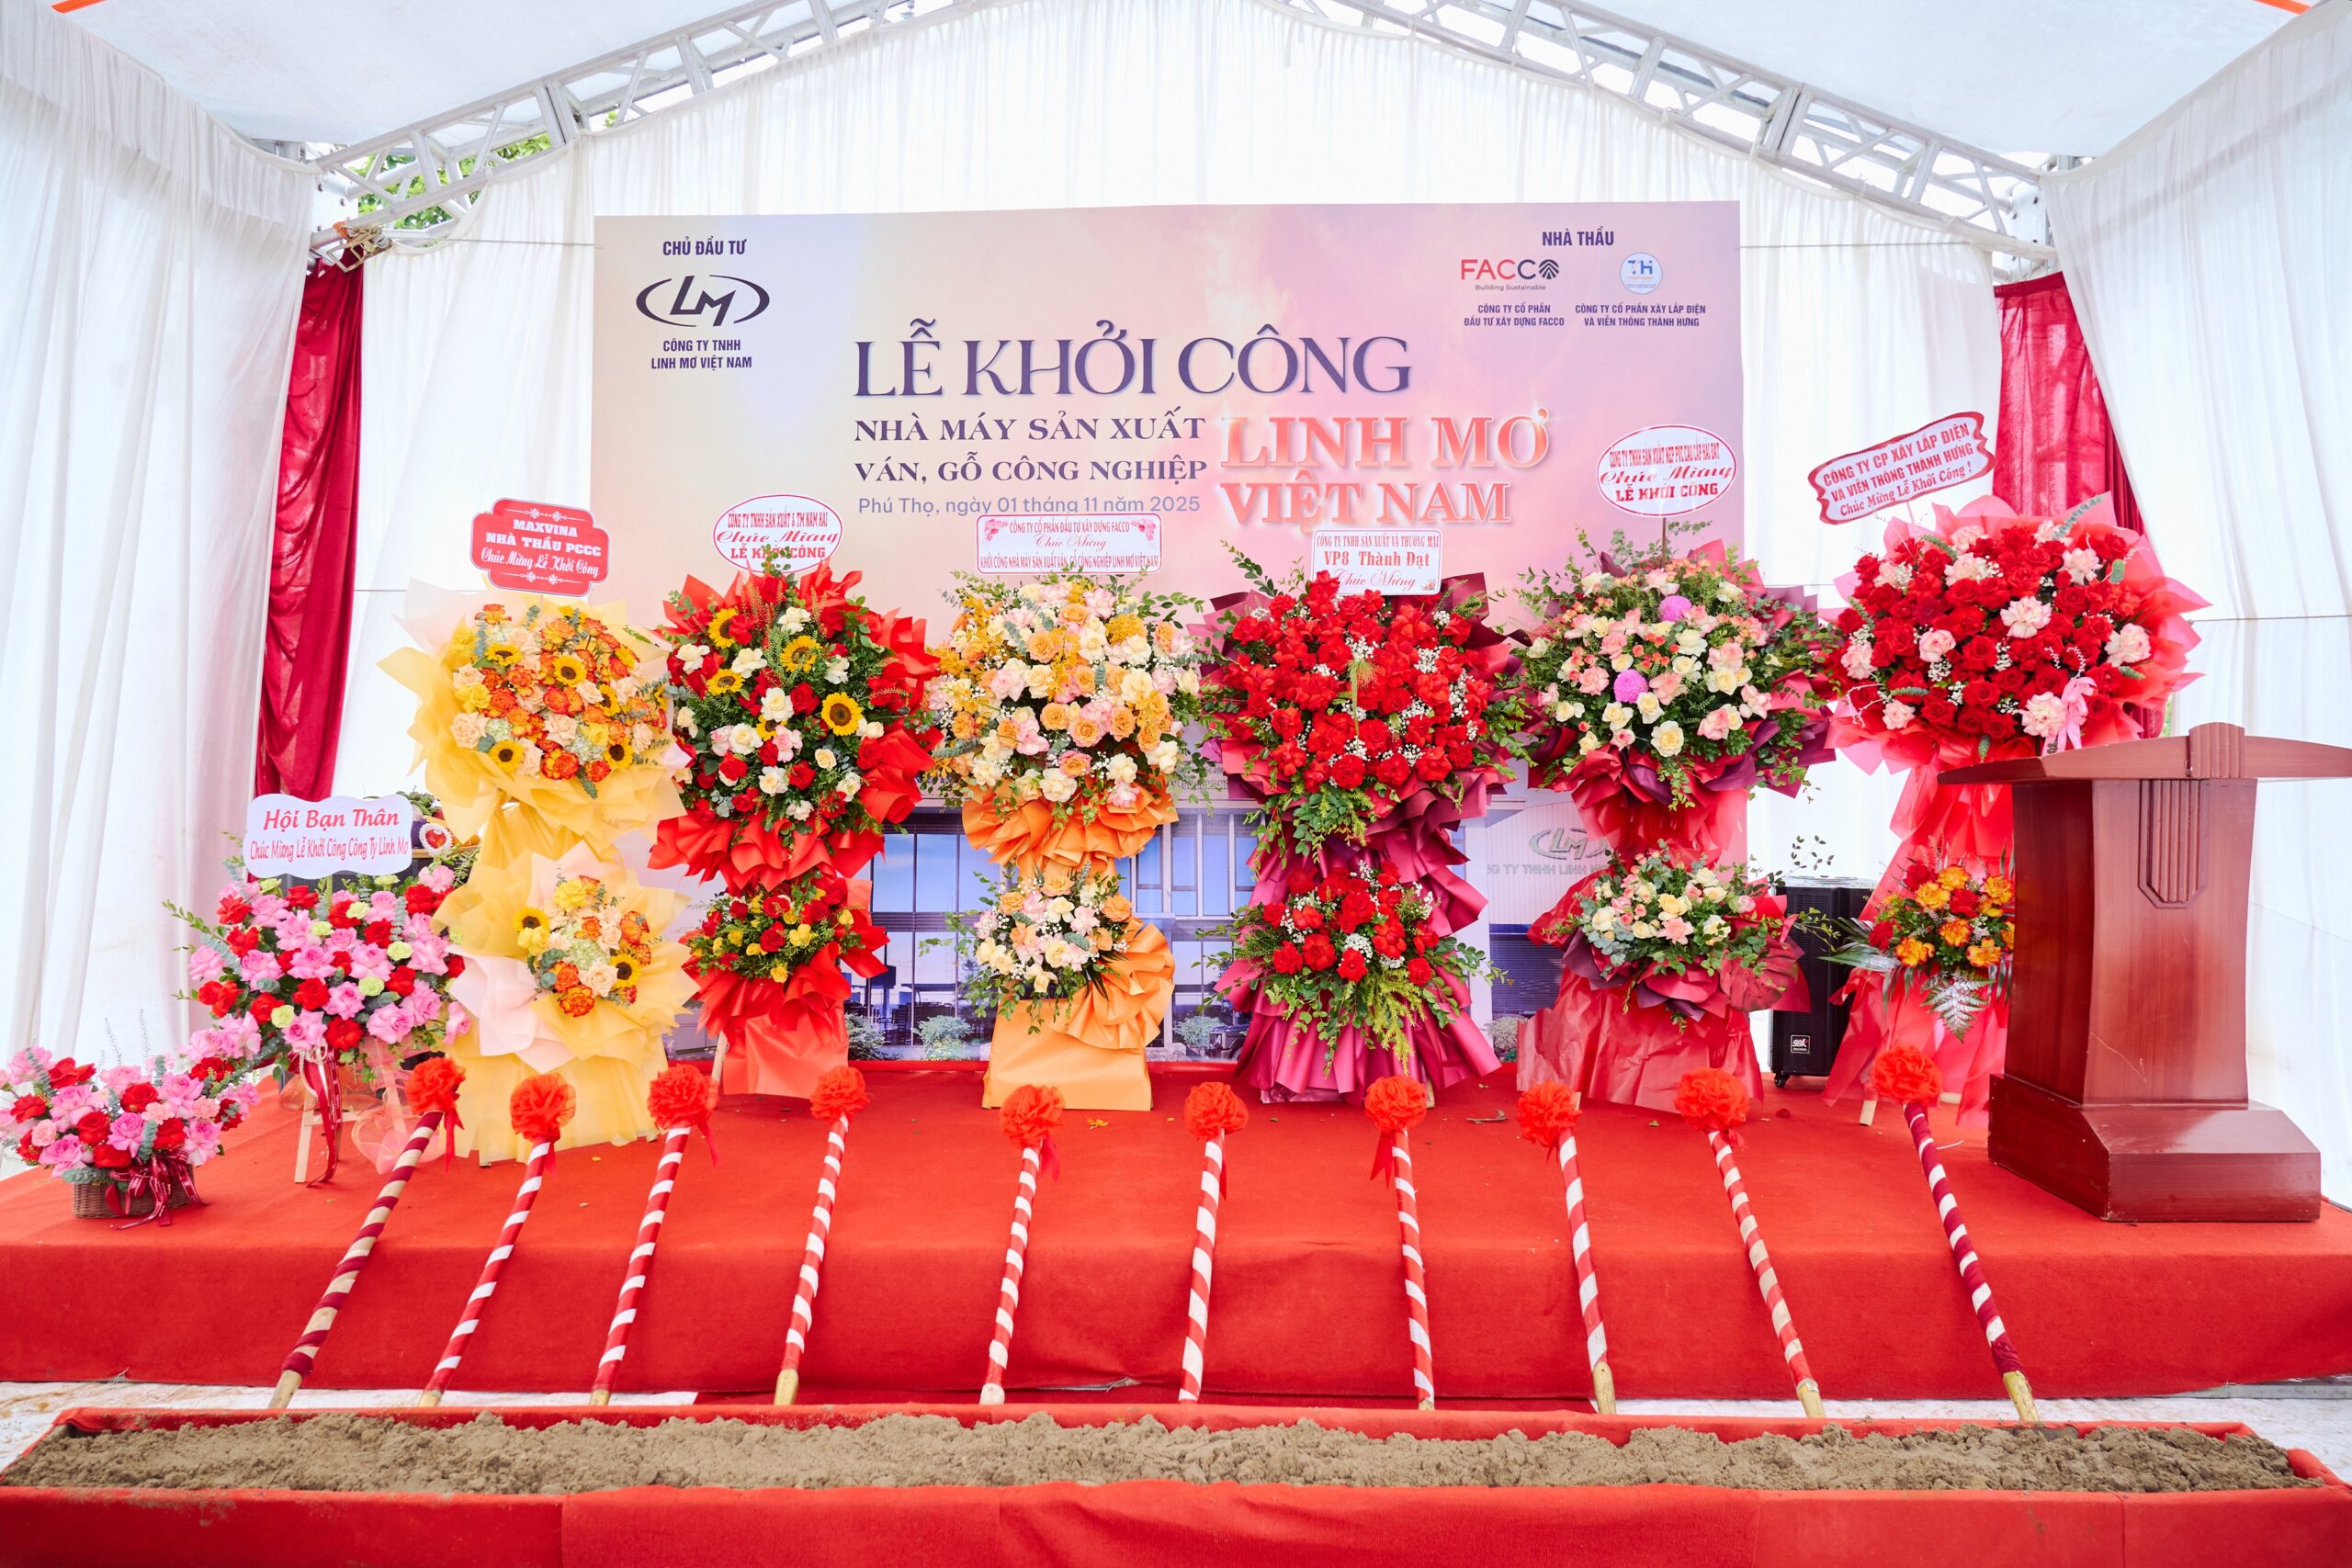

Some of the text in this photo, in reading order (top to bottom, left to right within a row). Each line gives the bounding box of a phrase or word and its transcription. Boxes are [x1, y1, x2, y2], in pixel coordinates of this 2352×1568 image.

[662, 236, 747, 255] CHỦ ĐẦU TƯ
[1542, 226, 1615, 246] NHÀ THẦU
[1477, 303, 1500, 313] CÔNG
[1503, 304, 1512, 313] TY
[1575, 303, 1598, 313] CÔNG
[1600, 304, 1610, 313] TY
[1650, 303, 1667, 313] XÂY
[1686, 303, 1706, 315] ĐIỆN
[1483, 317, 1494, 326] TƯ
[1496, 316, 1512, 326] XÂY
[1514, 317, 1536, 328] DỰNG
[1539, 318, 1565, 326] FACCO
[1584, 316, 1595, 326] VÀ
[1618, 316, 1645, 327] THÔNG
[1647, 316, 1674, 327] THÀNH
[1677, 317, 1700, 327] HƯNG
[663, 338, 741, 352] CÔNG TY TNHH
[651, 355, 752, 371] LINH MƠ VIỆT NAM
[853, 318, 1412, 397] LỄ KHỞI CÔNG
[854, 406, 1206, 441] NHÀ MÁY SẢN XUẤT
[1221, 407, 1550, 468] LINH MƠ
[1610, 449, 1642, 468] CÔNG TY TNHH
[1823, 423, 1971, 487] CÔNG TY CP XÂY LẮP ĐIỆN
[854, 451, 1207, 485] VÁN, GỖ CÔNG NGHIỆP
[1600, 465, 1733, 485] Chúc Mừng
[1871, 467, 1905, 489] THÔNG
[1905, 454, 1942, 476] THÀNH
[1943, 443, 1974, 462] HƯNG
[1615, 482, 1718, 502] LỄ KHỞI CÔNG
[1840, 501, 1865, 516] Chúc
[1867, 492, 1895, 509] Mừng
[1897, 480, 1910, 498] Lễ
[1939, 466, 1966, 481] Công
[859, 496, 1201, 518] Phú Thọ, ngày 01 tháng 11 năm 2025
[1220, 469, 1511, 533] VIỆT NAM
[514, 519, 578, 537] MAXVINA
[728, 511, 818, 528] CÔNG TY TNHH TM NAM
[1010, 520, 1025, 533] CÔNG
[1026, 522, 1034, 533] TY
[1073, 520, 1081, 532] TƯ
[1081, 519, 1093, 532] XÂY
[1094, 521, 1111, 535] DỰNG
[1112, 521, 1130, 532] FACCO
[486, 532, 602, 557] NHÀ THẦU PCCC
[717, 530, 838, 544] Chúc Mừng
[1035, 534, 1107, 551] Chúc Mừng
[1317, 534, 1332, 547] CÔNG
[1334, 536, 1340, 547] TY
[1343, 536, 1359, 547] TNHH
[730, 543, 748, 558] LỄ
[791, 545, 826, 558] CÔNG
[481, 547, 600, 579] Chúc Mừng Lễ Khởi Công
[1324, 551, 1430, 570] VP8 Thành Đạt
[1370, 569, 1416, 591] Mừng
[264, 808, 400, 832] Hội Bạn Thân
[250, 840, 269, 861] Chúc
[271, 840, 294, 863] Mừng
[296, 836, 306, 858] Lễ
[327, 838, 346, 861] Công
[348, 837, 368, 860] Công
[369, 837, 377, 860] Ty
[1503, 863, 1520, 874] TY
[1522, 863, 1555, 874] TNHH
[1559, 863, 1587, 874] LINH
